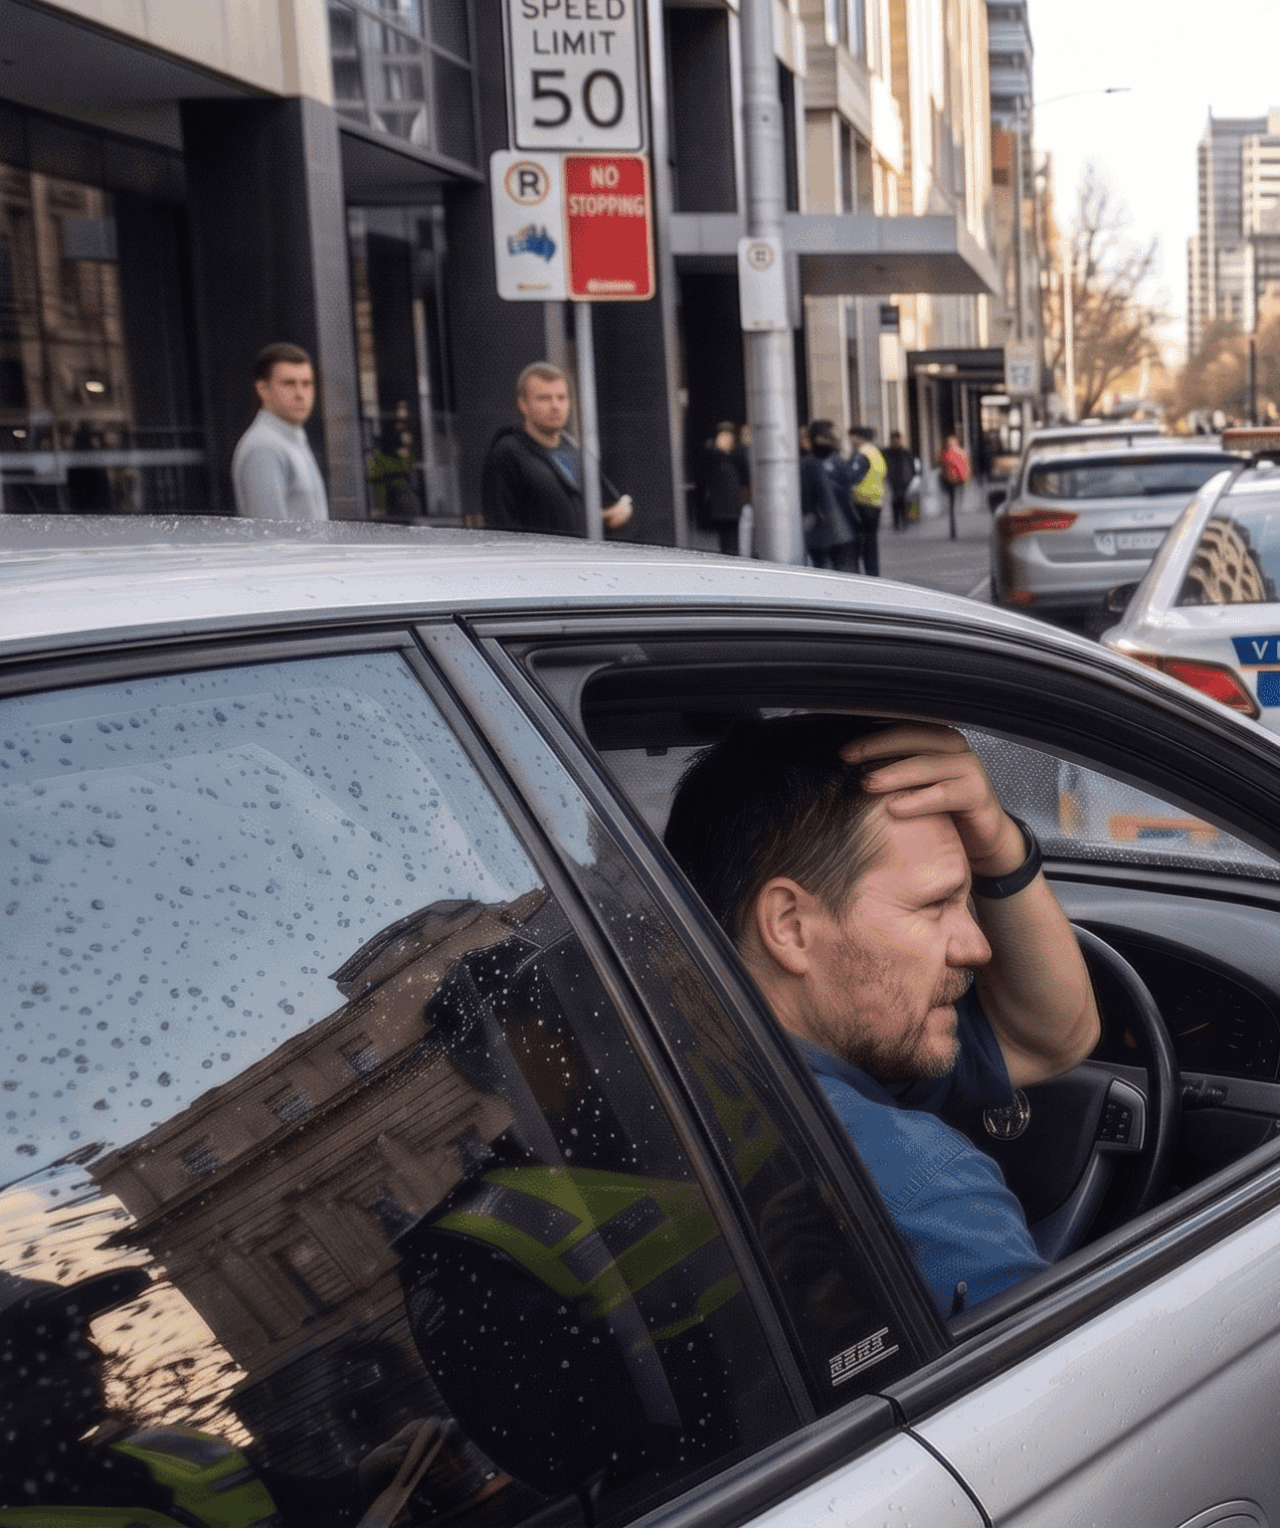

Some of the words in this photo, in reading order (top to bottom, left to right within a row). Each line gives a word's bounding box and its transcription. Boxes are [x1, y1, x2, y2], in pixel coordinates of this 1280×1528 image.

[521, 0, 625, 20] SPEED
[533, 30, 616, 56] LIMIT
[530, 68, 625, 128] 50
[590, 165, 620, 189] NO
[567, 194, 646, 217] STOPPING
